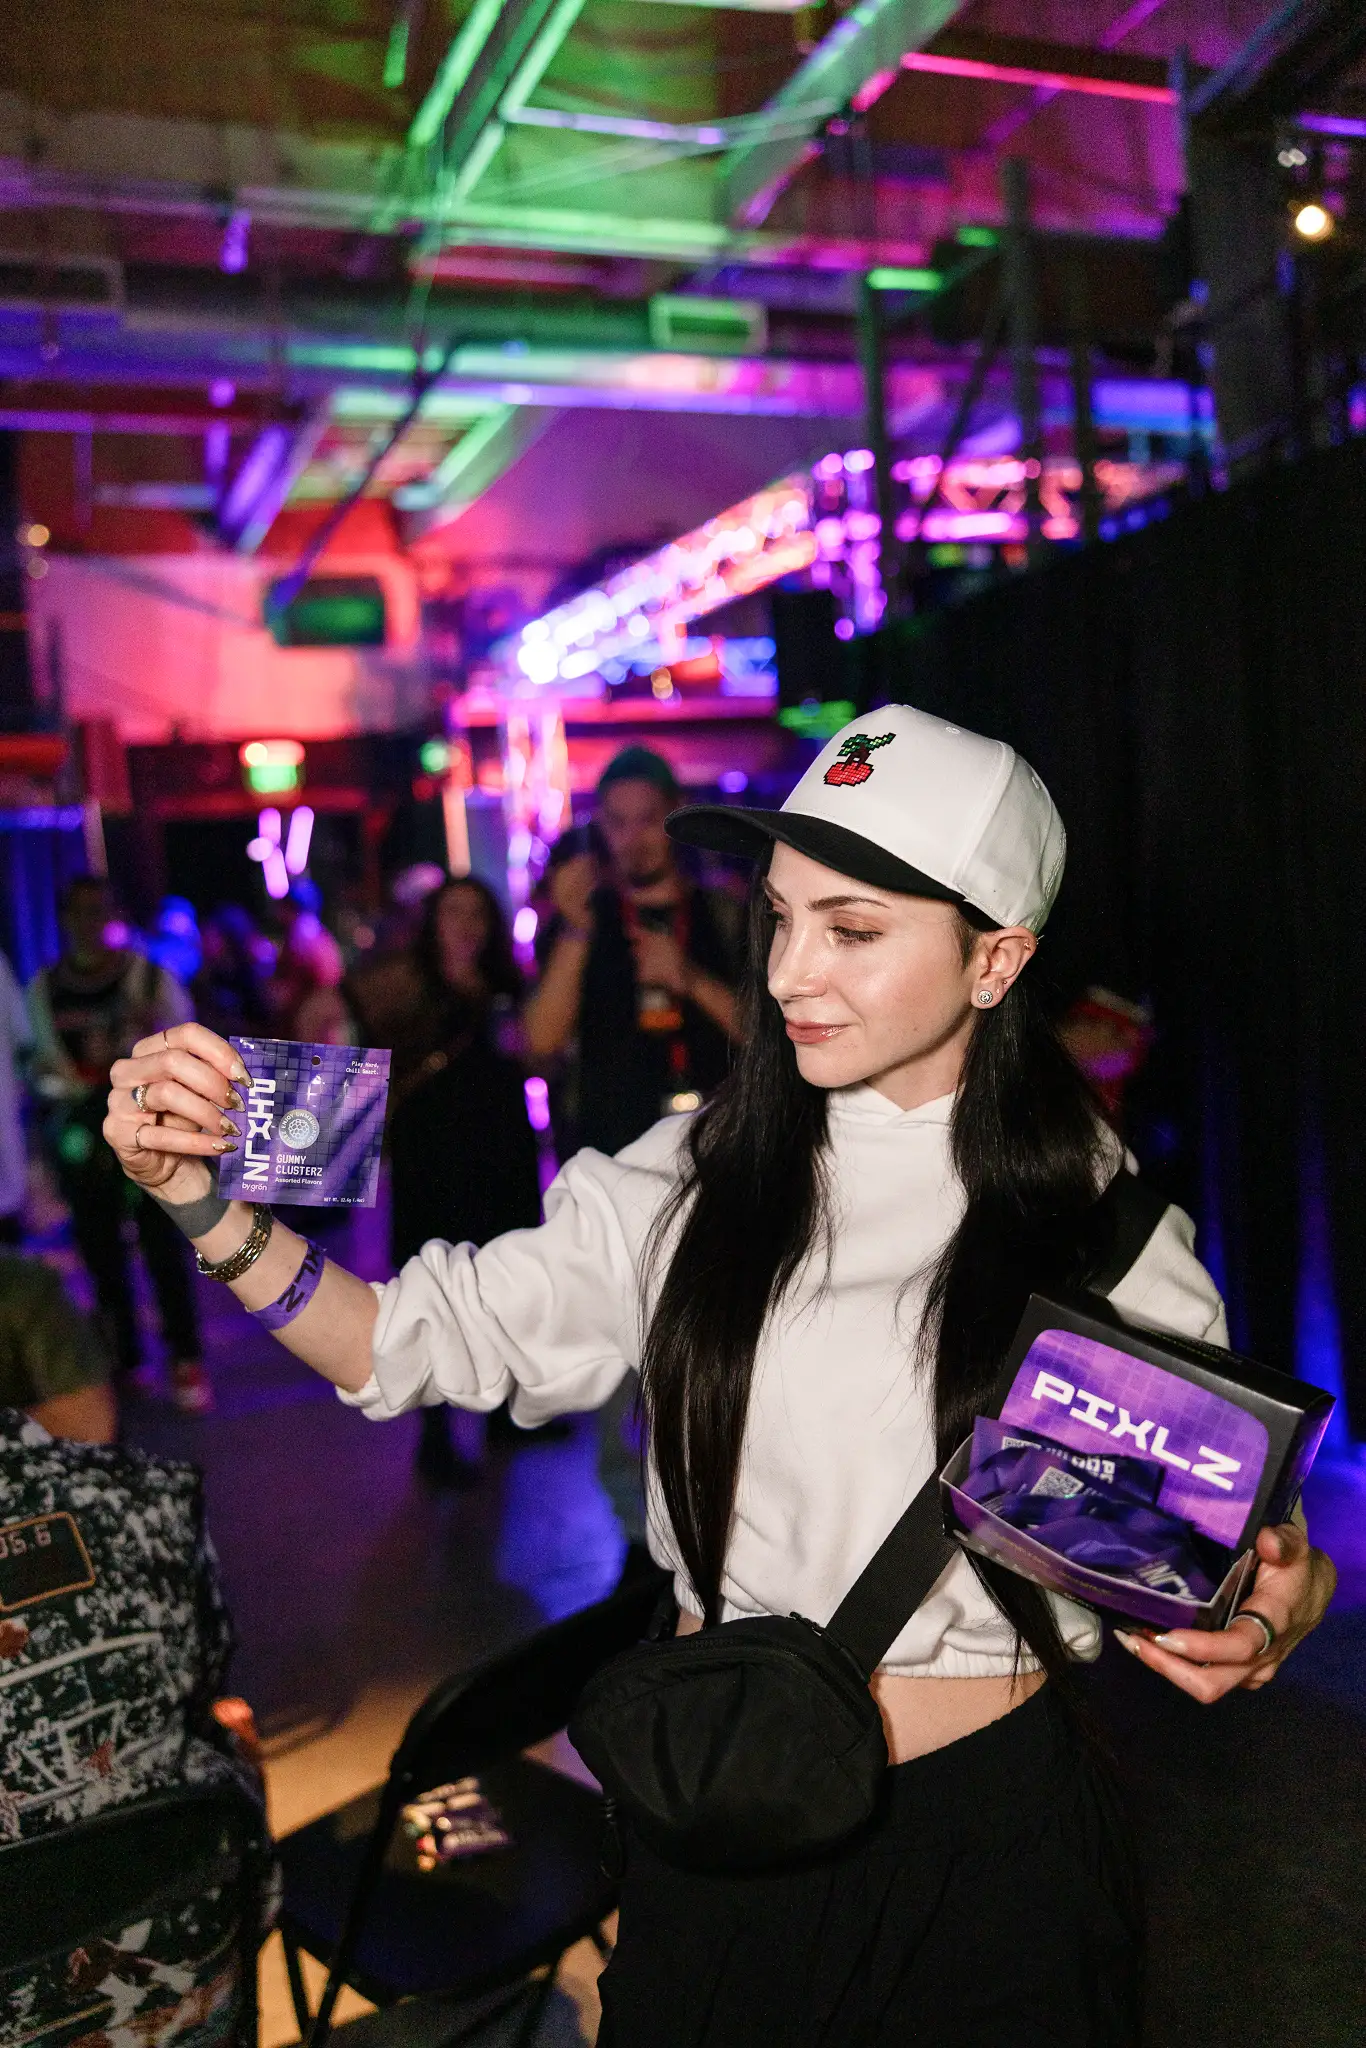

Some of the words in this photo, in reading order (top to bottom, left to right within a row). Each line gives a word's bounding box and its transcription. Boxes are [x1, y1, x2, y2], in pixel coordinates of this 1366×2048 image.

[351, 1060, 363, 1068] Play
[242, 1077, 276, 1182] PIXLZ
[276, 1153, 307, 1165] GUMMY
[275, 1165, 323, 1177] CLUSTERZ
[1030, 1369, 1242, 1492] PIXLZ
